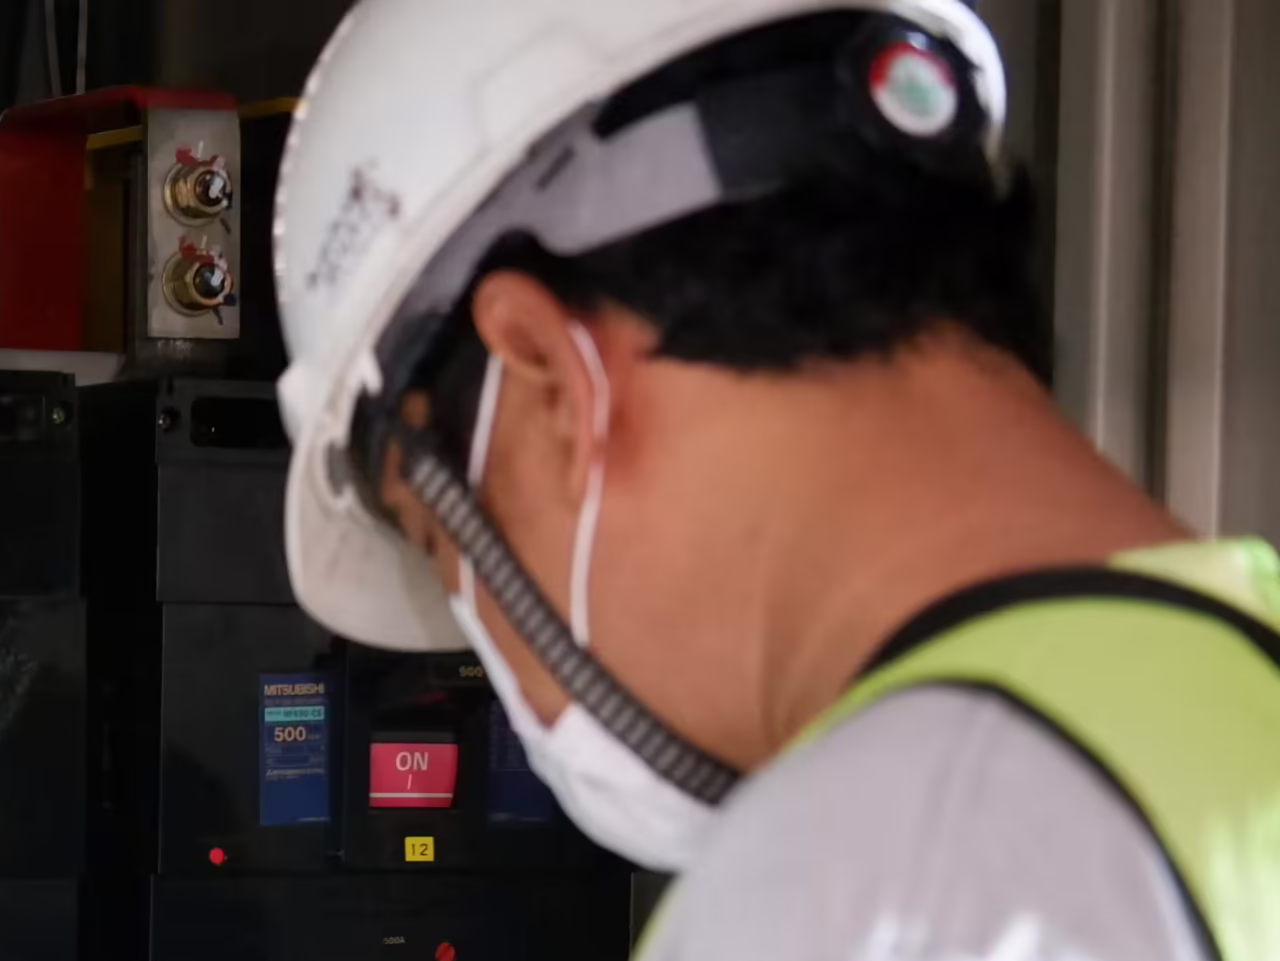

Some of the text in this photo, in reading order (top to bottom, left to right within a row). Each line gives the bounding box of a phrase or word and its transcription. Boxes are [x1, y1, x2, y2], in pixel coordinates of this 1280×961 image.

[264, 683, 325, 696] MITSUBISHI
[274, 726, 307, 742] 500
[395, 752, 429, 771] ON
[411, 843, 429, 856] 12
